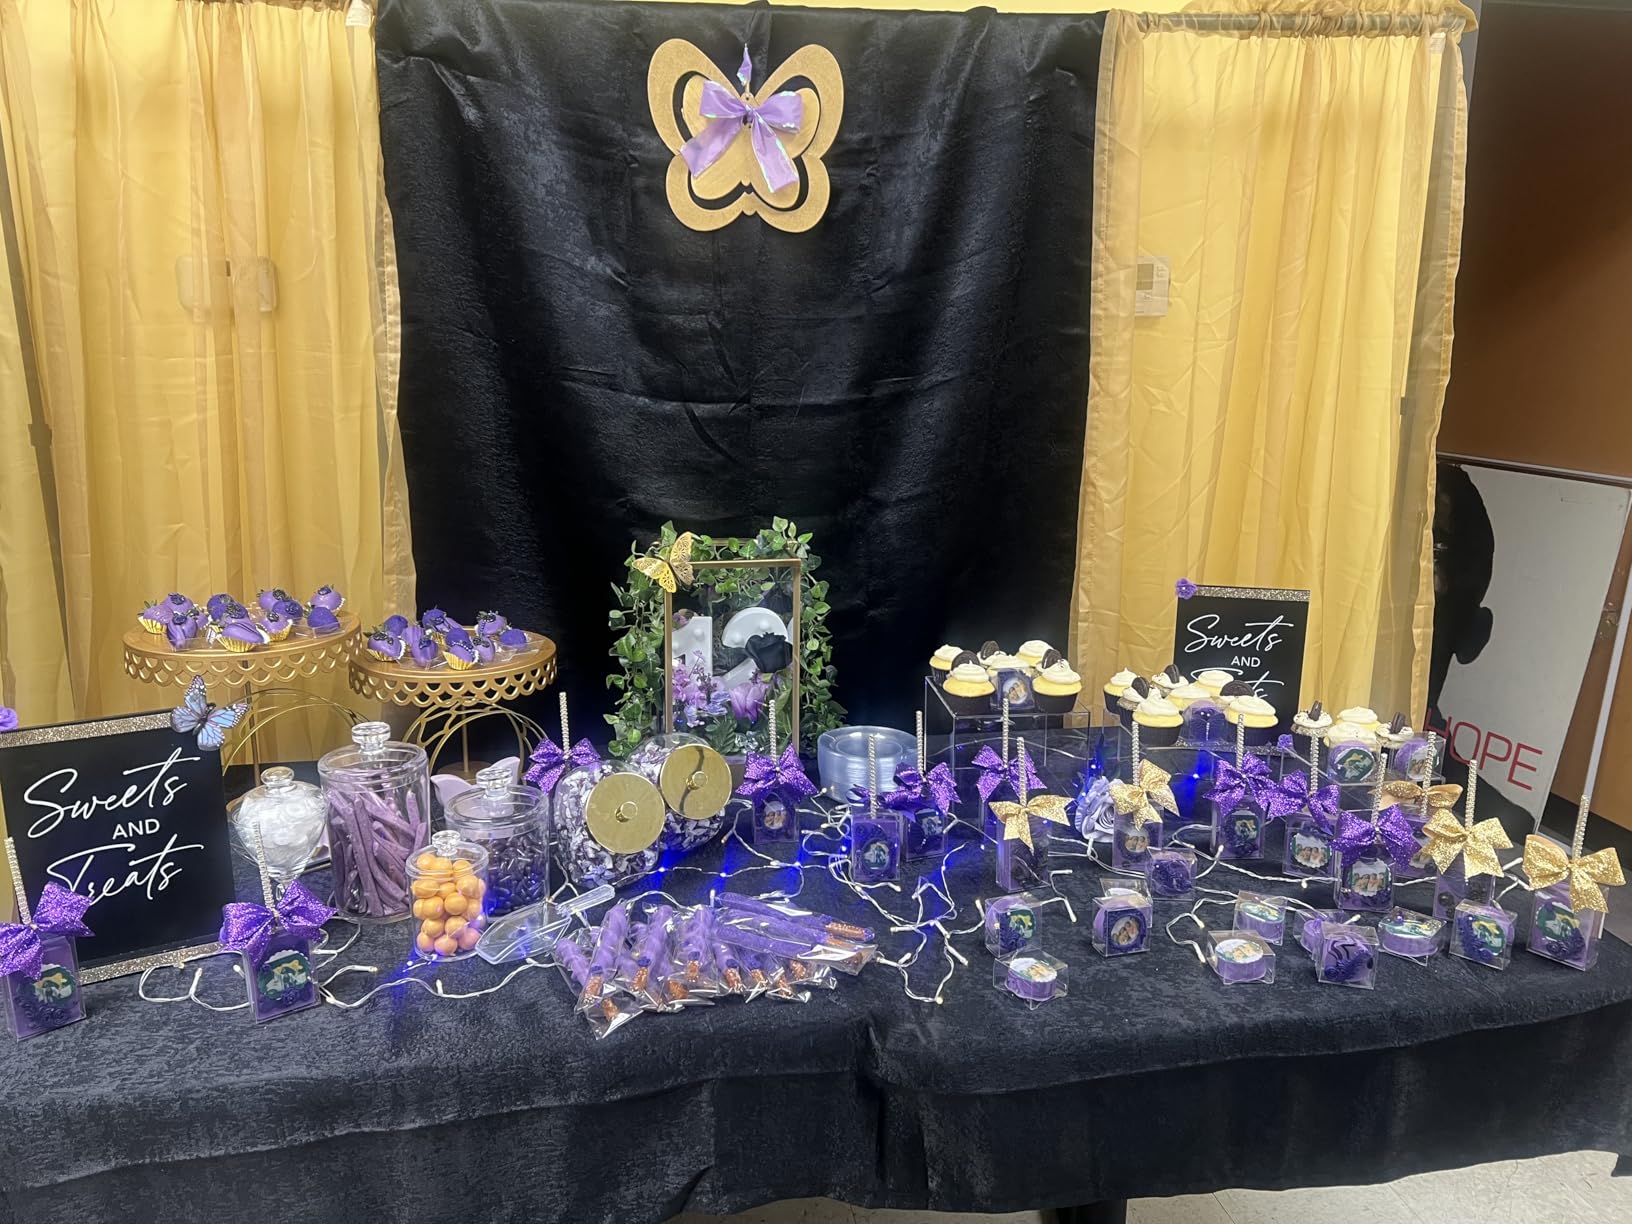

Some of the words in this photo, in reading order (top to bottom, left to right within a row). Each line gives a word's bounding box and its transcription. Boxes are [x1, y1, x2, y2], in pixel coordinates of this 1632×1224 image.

[1184, 614, 1294, 653] Sweets
[1230, 655, 1261, 668] AND
[1423, 708, 1543, 791] HOPE
[24, 747, 200, 838] Sweets
[112, 818, 160, 840] AND
